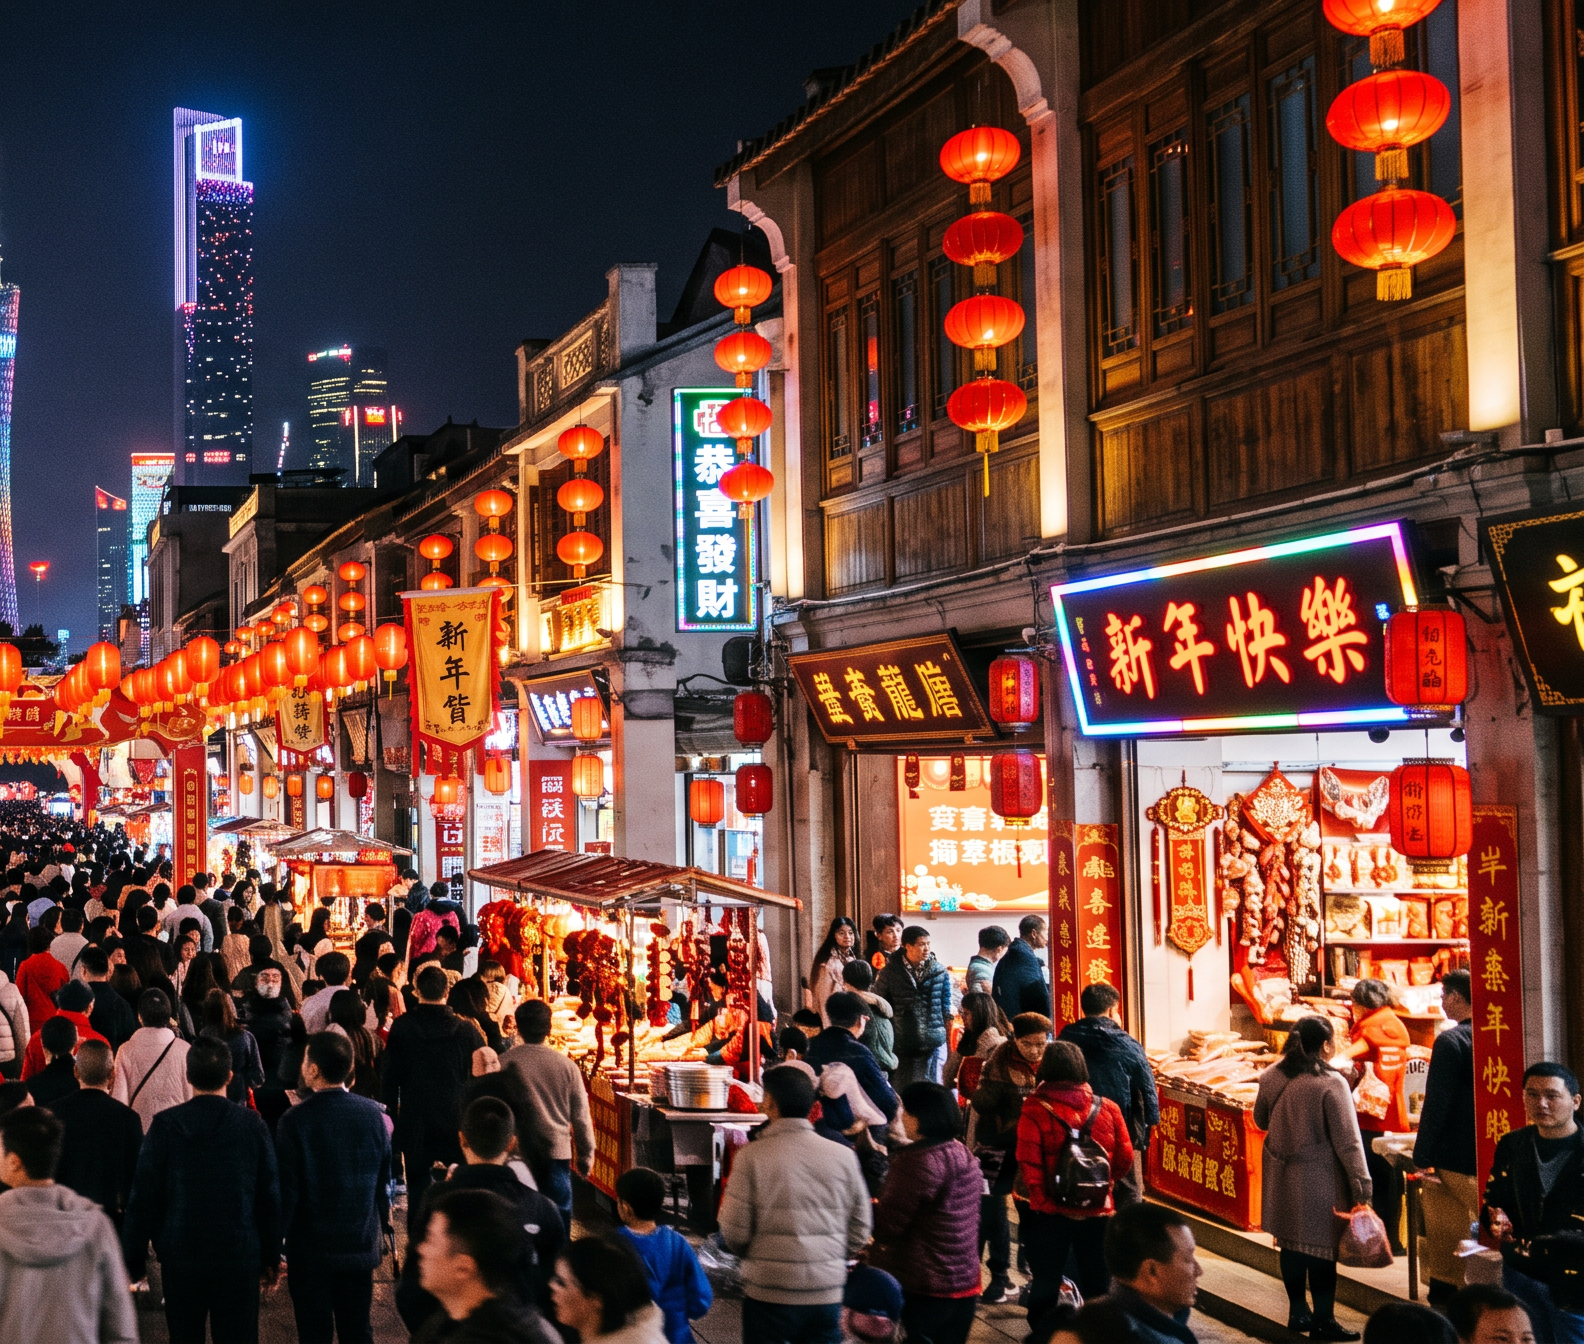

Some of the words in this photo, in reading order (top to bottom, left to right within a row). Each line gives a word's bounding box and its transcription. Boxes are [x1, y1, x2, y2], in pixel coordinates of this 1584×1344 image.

[693, 444, 738, 619] 恭喜發財
[1104, 576, 1368, 700] 新年快樂
